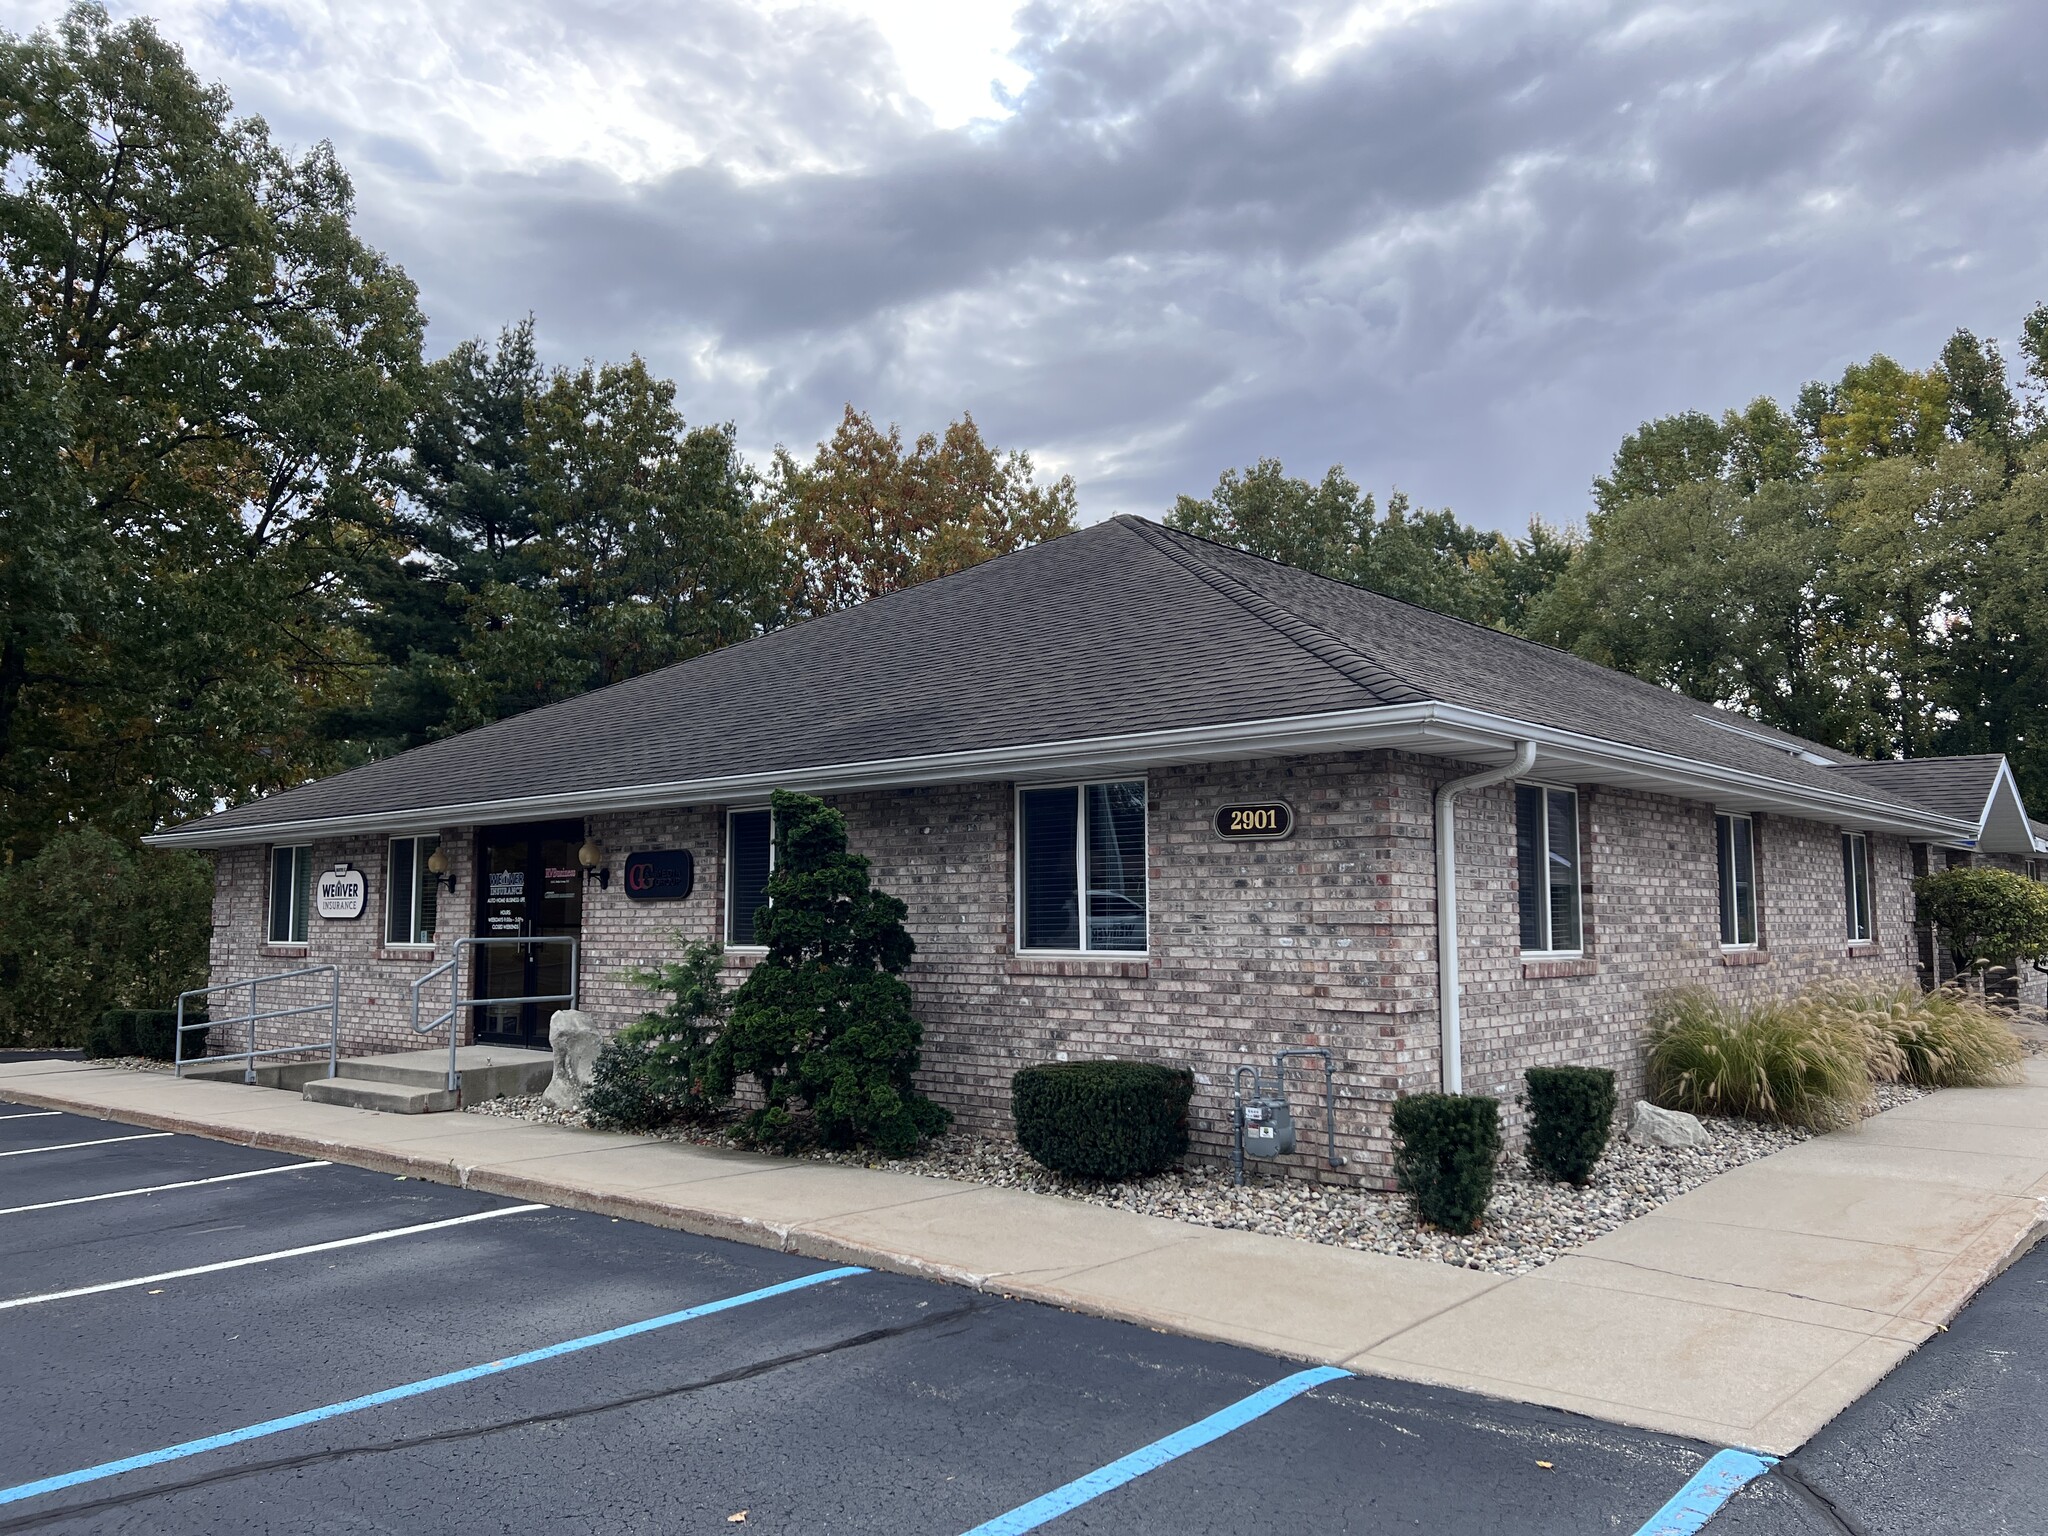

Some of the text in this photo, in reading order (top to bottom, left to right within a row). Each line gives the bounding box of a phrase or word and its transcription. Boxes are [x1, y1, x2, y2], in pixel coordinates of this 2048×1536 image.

[1230, 809, 1277, 830] 2901
[489, 870, 525, 886] WEAVER
[322, 880, 359, 898] WEAVER
[490, 886, 523, 896] INSURANCE
[322, 901, 357, 910] INSURANCE
